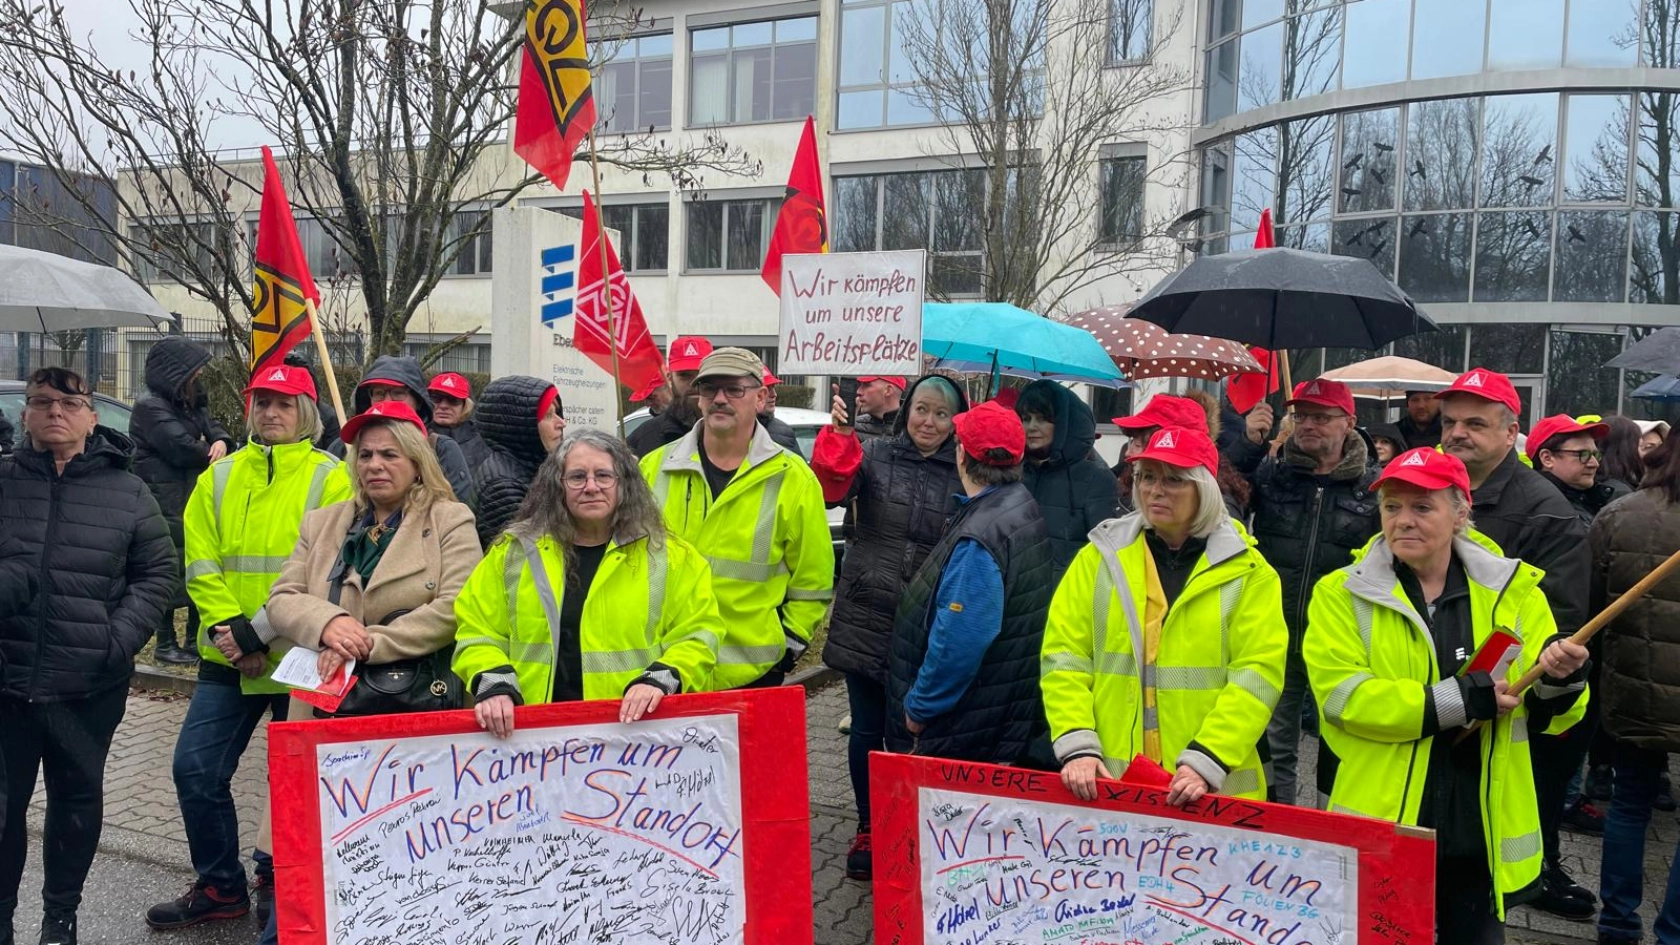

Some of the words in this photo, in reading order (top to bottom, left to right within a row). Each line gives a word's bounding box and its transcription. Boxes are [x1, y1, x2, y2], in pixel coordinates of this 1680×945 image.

[788, 268, 839, 298] Wir
[844, 269, 916, 298] kämpfen
[805, 309, 831, 324] um
[842, 305, 904, 323] unsere
[784, 329, 918, 364] Arbeitsplätze
[321, 743, 424, 818] Wir
[617, 742, 683, 770] um
[941, 764, 1047, 793] UNSERE
[406, 785, 532, 863] unseren
[564, 769, 740, 869] Standort
[927, 803, 1016, 860] Wir
[1246, 860, 1322, 906] um
[985, 869, 1126, 906] unseren
